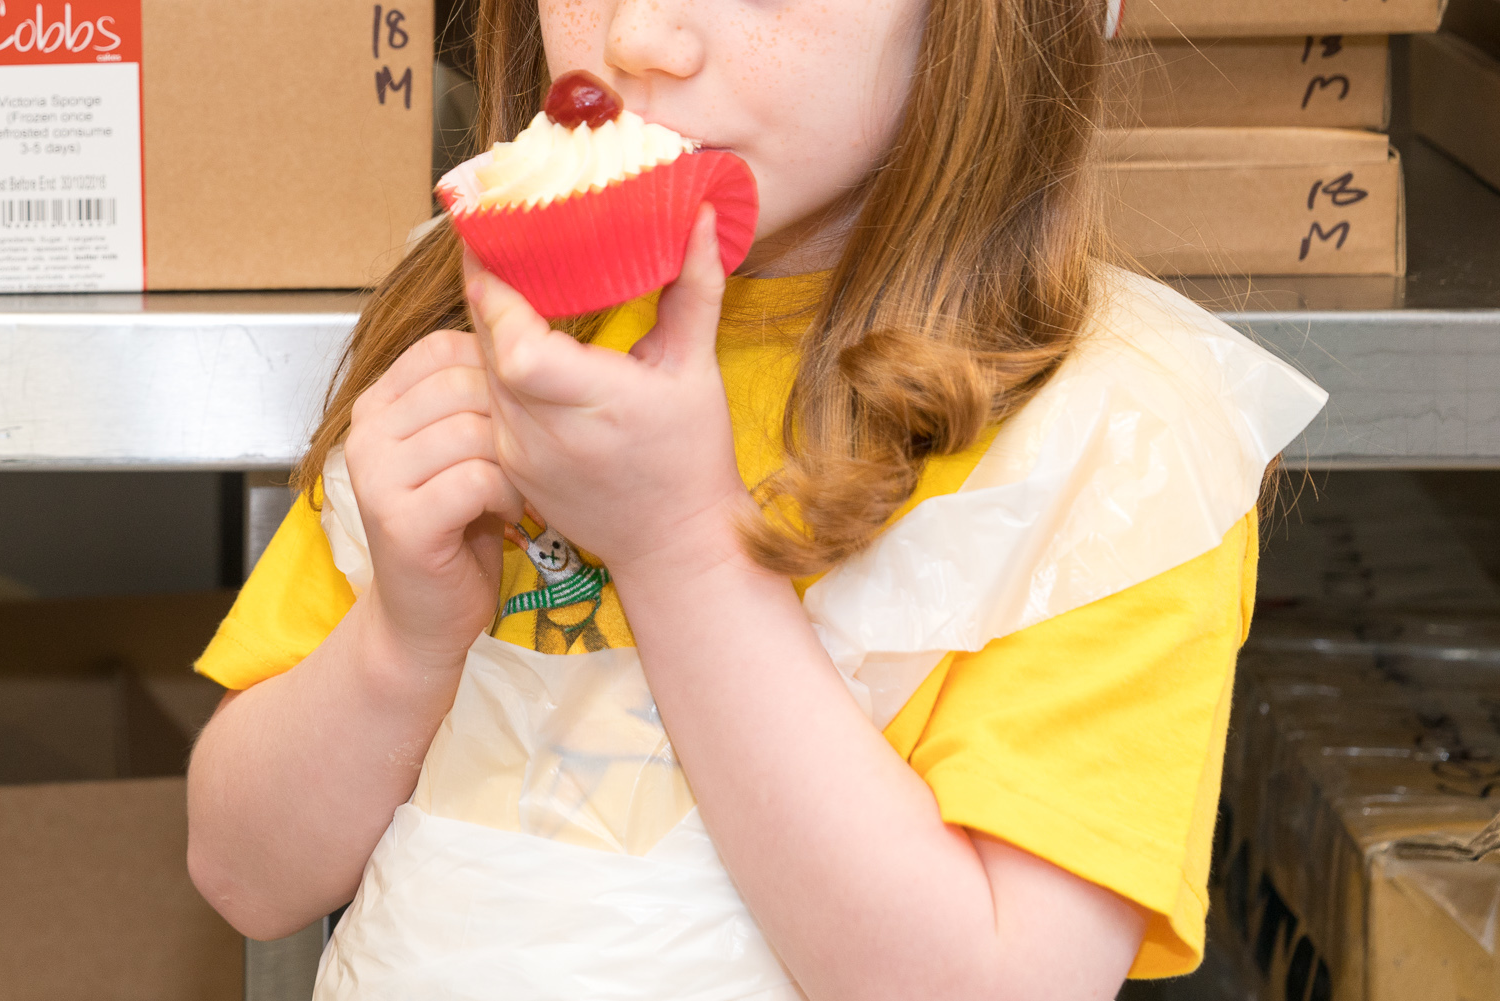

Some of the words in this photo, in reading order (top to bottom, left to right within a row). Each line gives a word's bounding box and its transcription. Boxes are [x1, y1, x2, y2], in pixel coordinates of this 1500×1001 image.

[372, 4, 409, 60] 18
[96, 53, 122, 62] cakes
[375, 65, 412, 110] M
[51, 94, 102, 108] Sponge
[6, 111, 58, 125] (Frozen
[60, 111, 93, 122] once
[52, 127, 113, 138] consume
[20, 143, 41, 155] 3-5
[44, 142, 81, 156] days)
[1307, 172, 1369, 211] 18
